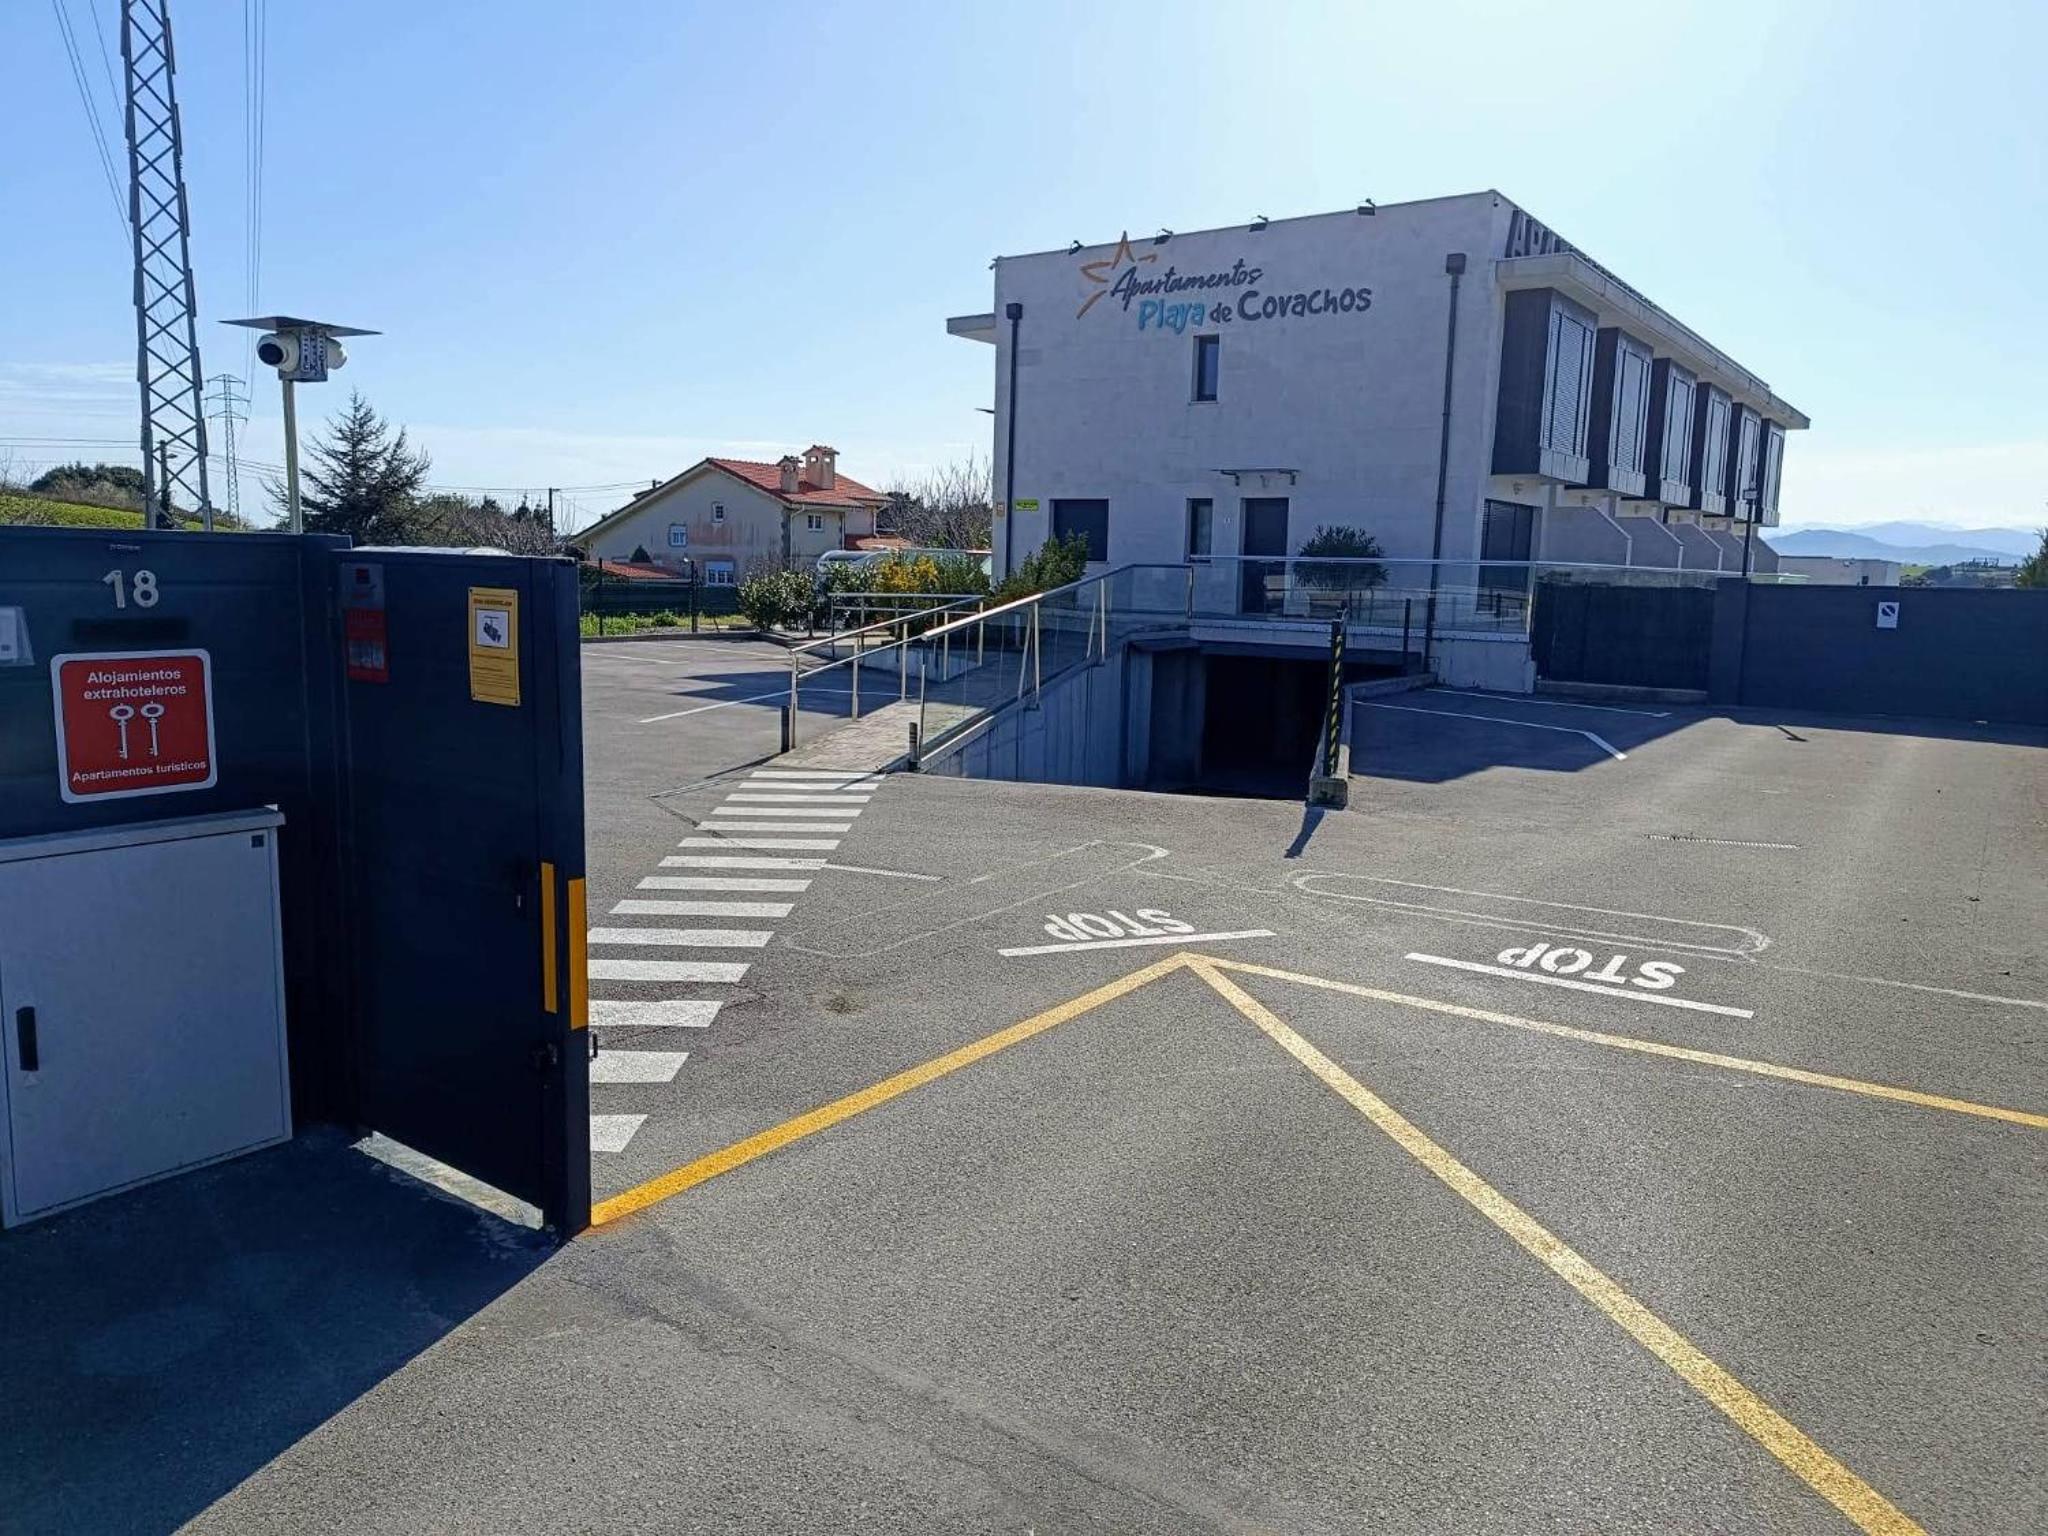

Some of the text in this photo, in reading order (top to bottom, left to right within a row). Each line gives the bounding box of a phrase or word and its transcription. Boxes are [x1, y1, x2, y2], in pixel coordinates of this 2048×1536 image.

[1110, 258, 1264, 312] Apartamentos
[1138, 298, 1205, 334] Playa
[1209, 302, 1233, 324] de
[102, 569, 160, 609] 18
[83, 684, 187, 700] extrahoteleros
[87, 669, 182, 686] Alojamientos
[72, 766, 153, 783] Apartamentos
[1044, 908, 1195, 940] STOP
[1497, 942, 1687, 990] STOP
